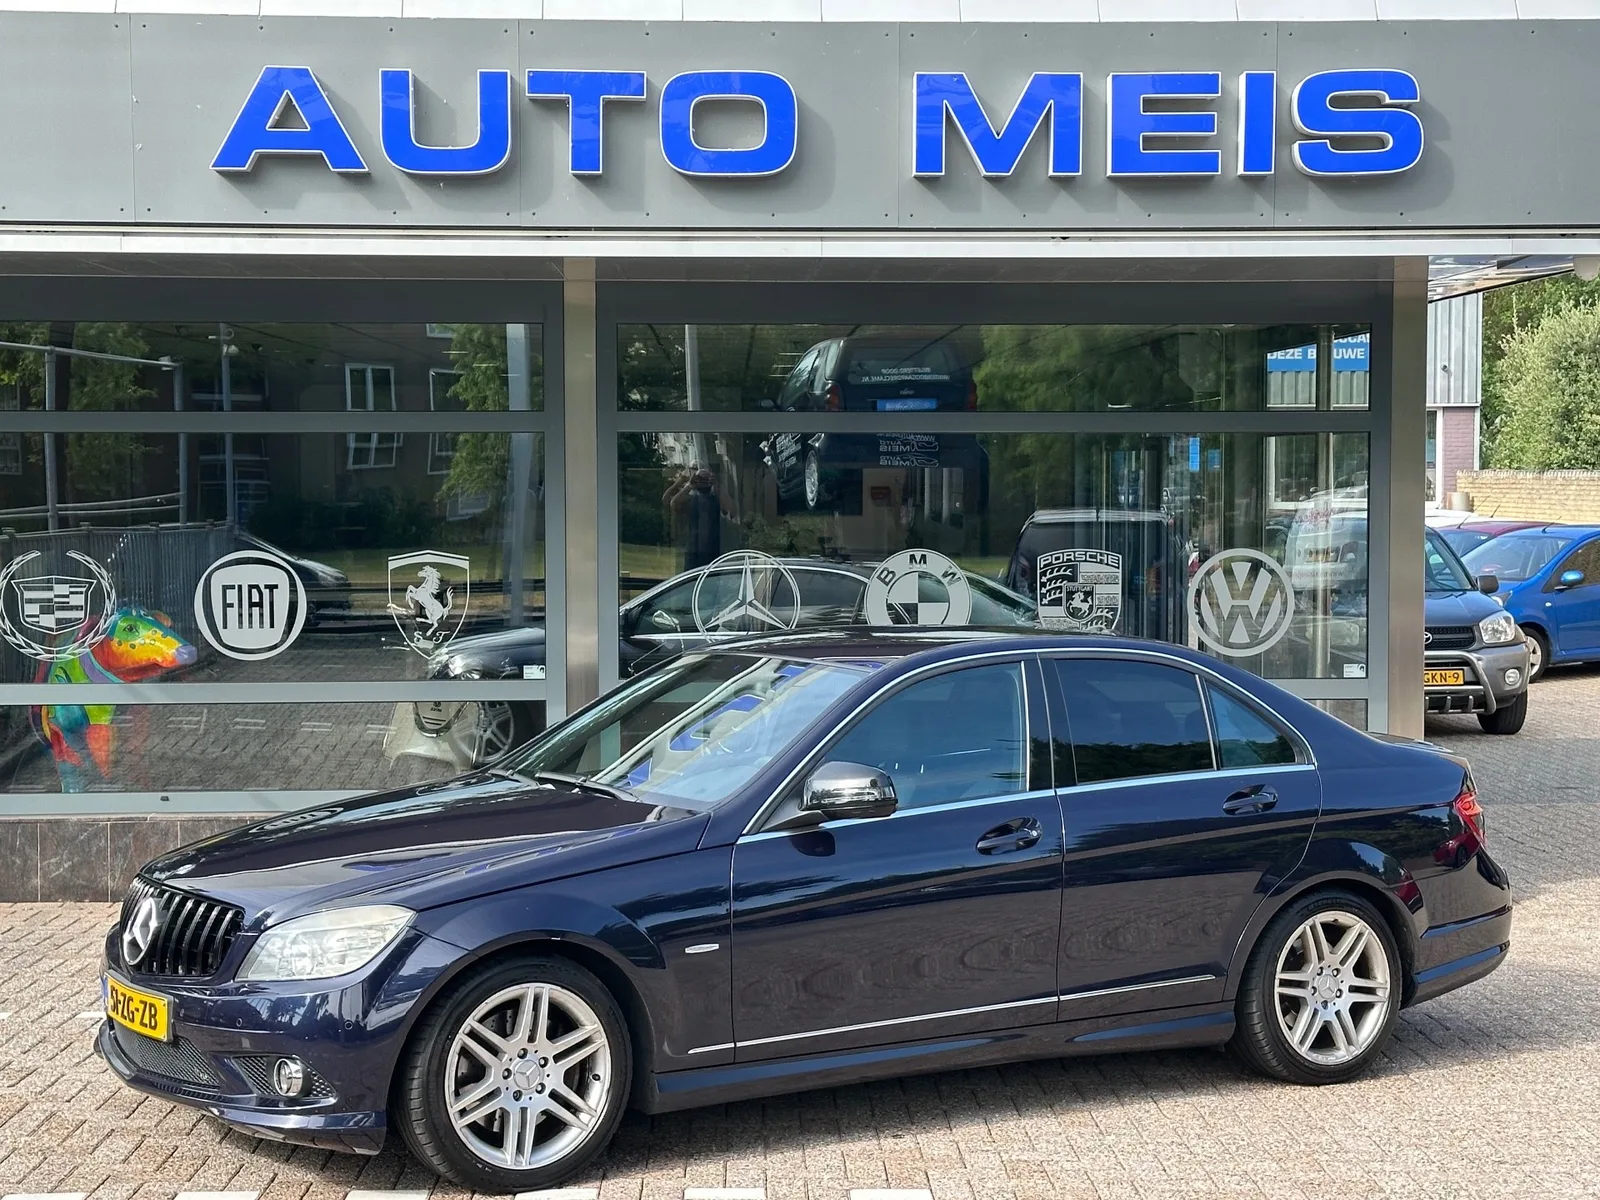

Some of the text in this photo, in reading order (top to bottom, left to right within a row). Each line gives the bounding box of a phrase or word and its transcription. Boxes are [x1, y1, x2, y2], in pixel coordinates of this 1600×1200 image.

[210, 65, 1424, 178] AUTO MEIS
[876, 553, 962, 587] BMW
[1040, 551, 1119, 568] PORSCHE
[221, 583, 279, 629] FIAT
[110, 984, 158, 1031] 51-ZG-ZB
